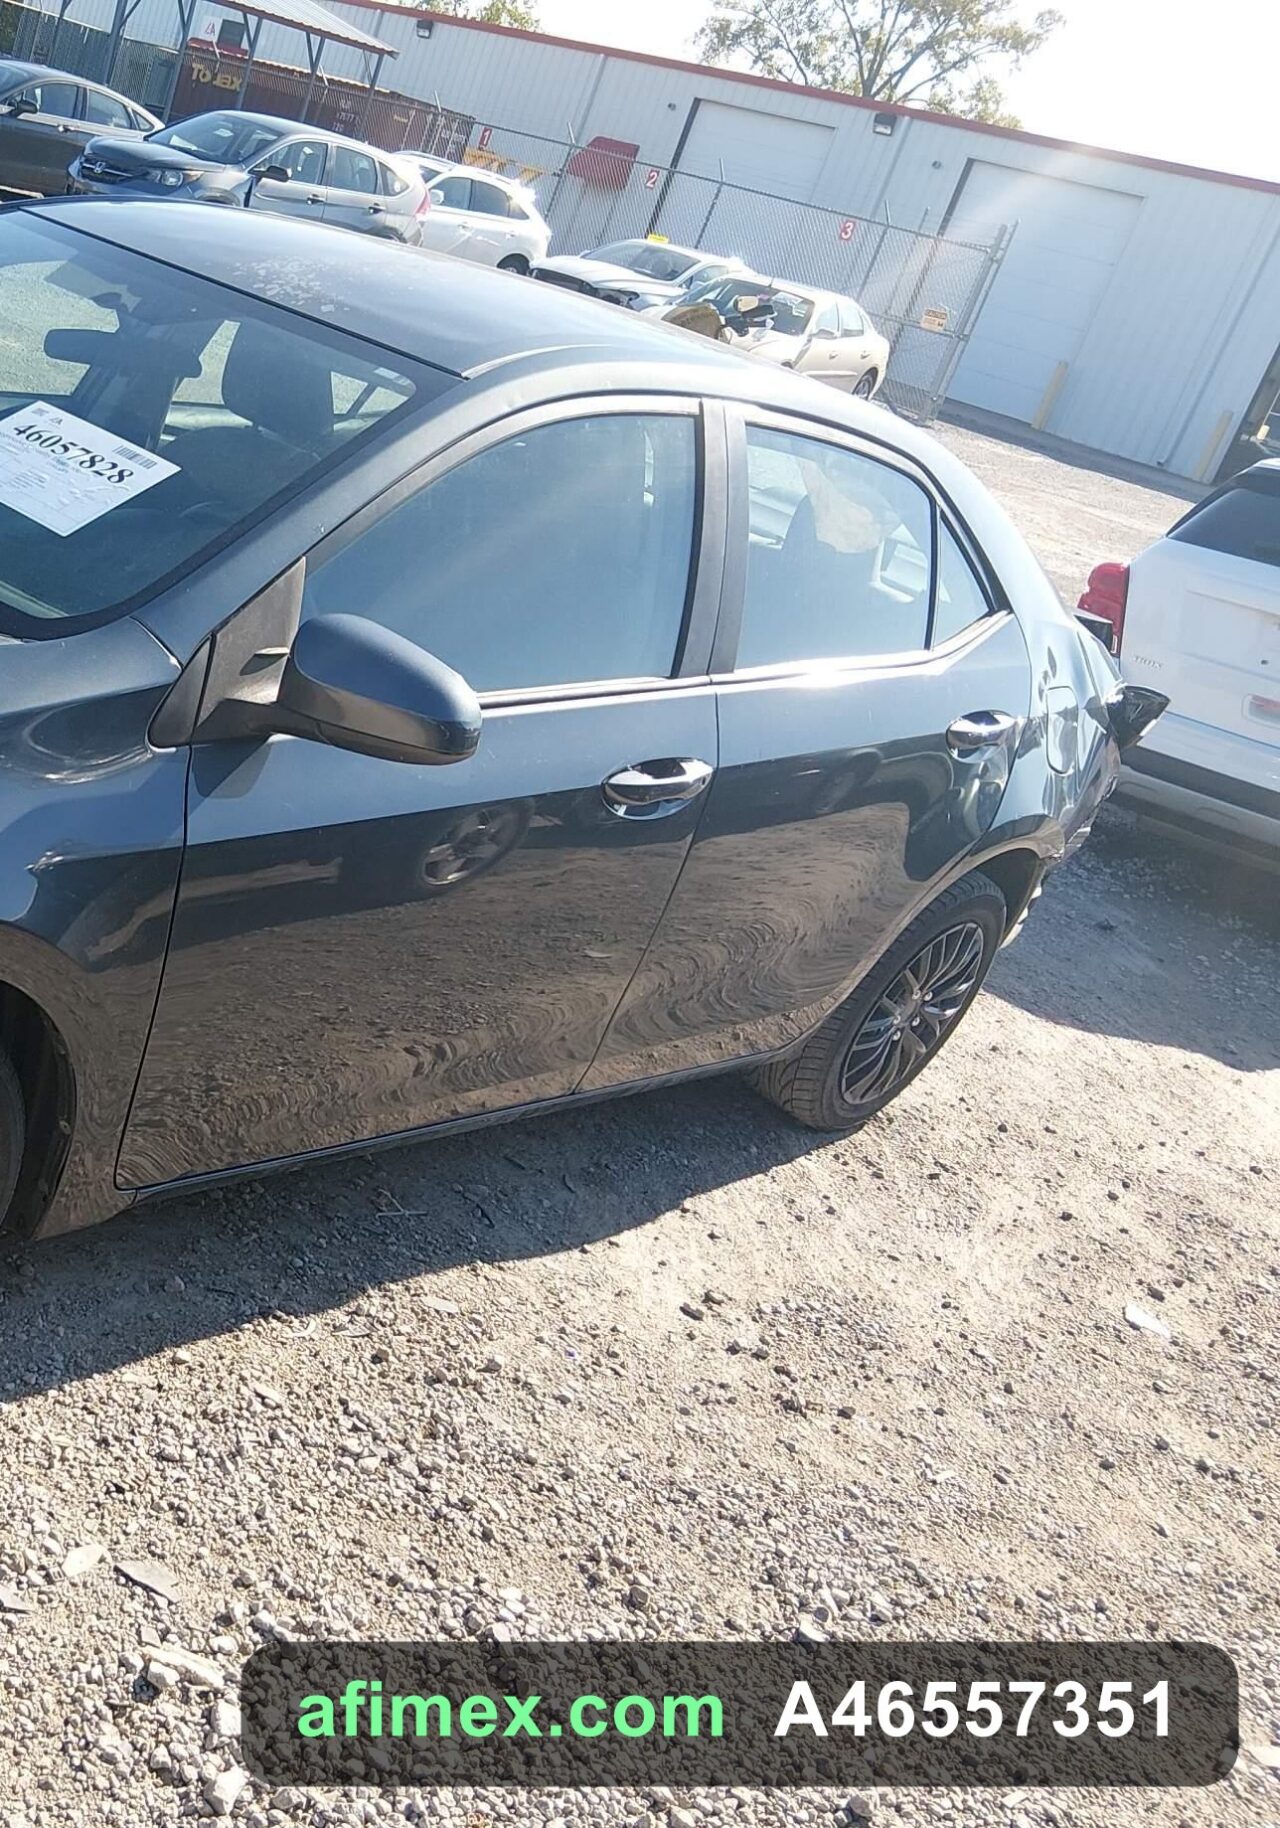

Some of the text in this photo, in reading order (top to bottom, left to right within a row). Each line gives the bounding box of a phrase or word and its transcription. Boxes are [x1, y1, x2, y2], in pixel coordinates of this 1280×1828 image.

[646, 171, 658, 188] 2
[841, 222, 854, 239] 3
[13, 424, 135, 484] 46057828
